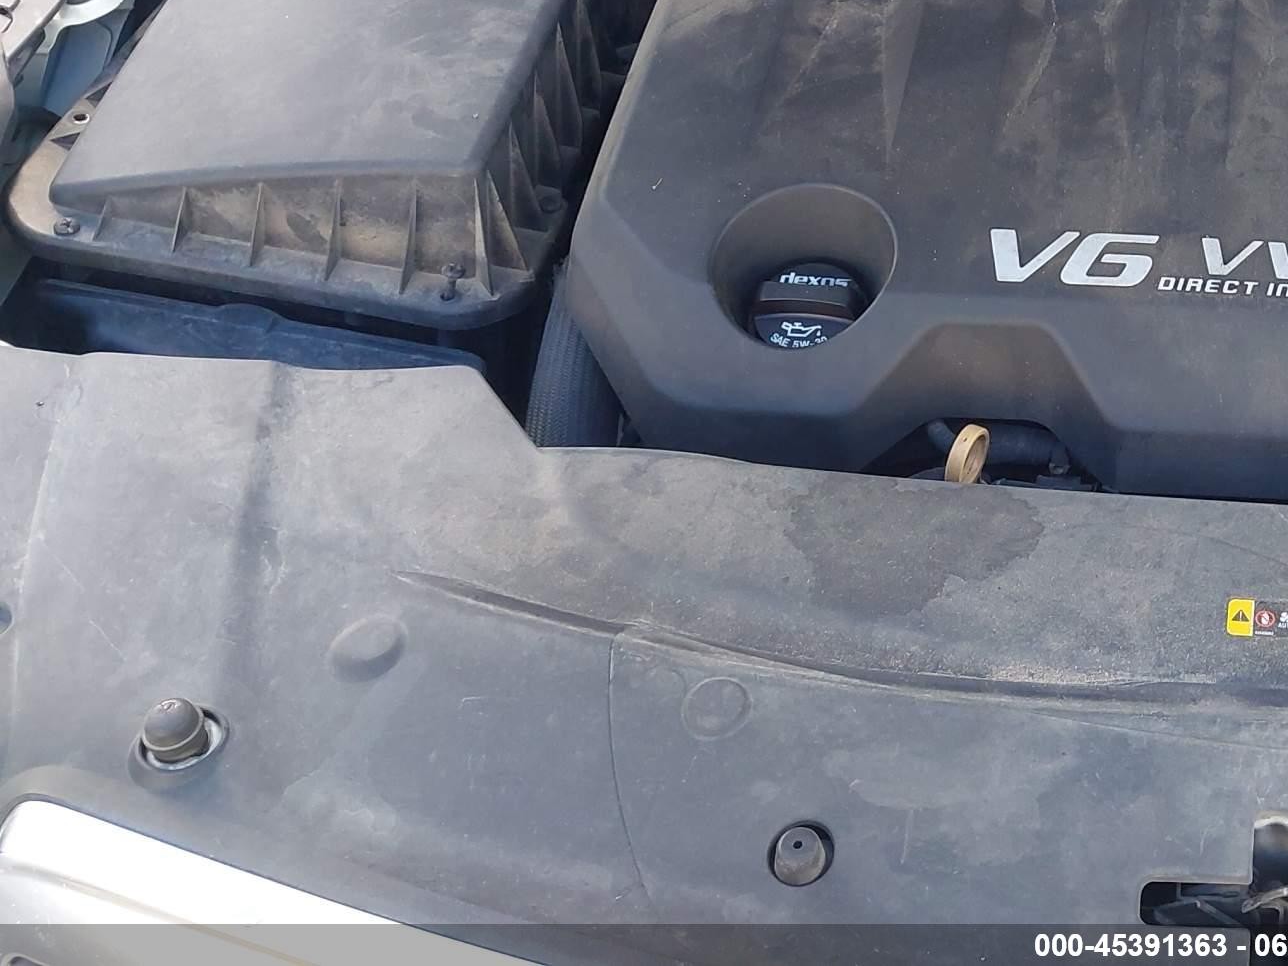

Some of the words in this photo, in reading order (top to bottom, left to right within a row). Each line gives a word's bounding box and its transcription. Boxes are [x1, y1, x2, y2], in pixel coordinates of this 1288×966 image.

[990, 228, 1160, 287] V6
[1157, 276, 1260, 296] DIRECT
[770, 332, 791, 348] SAE
